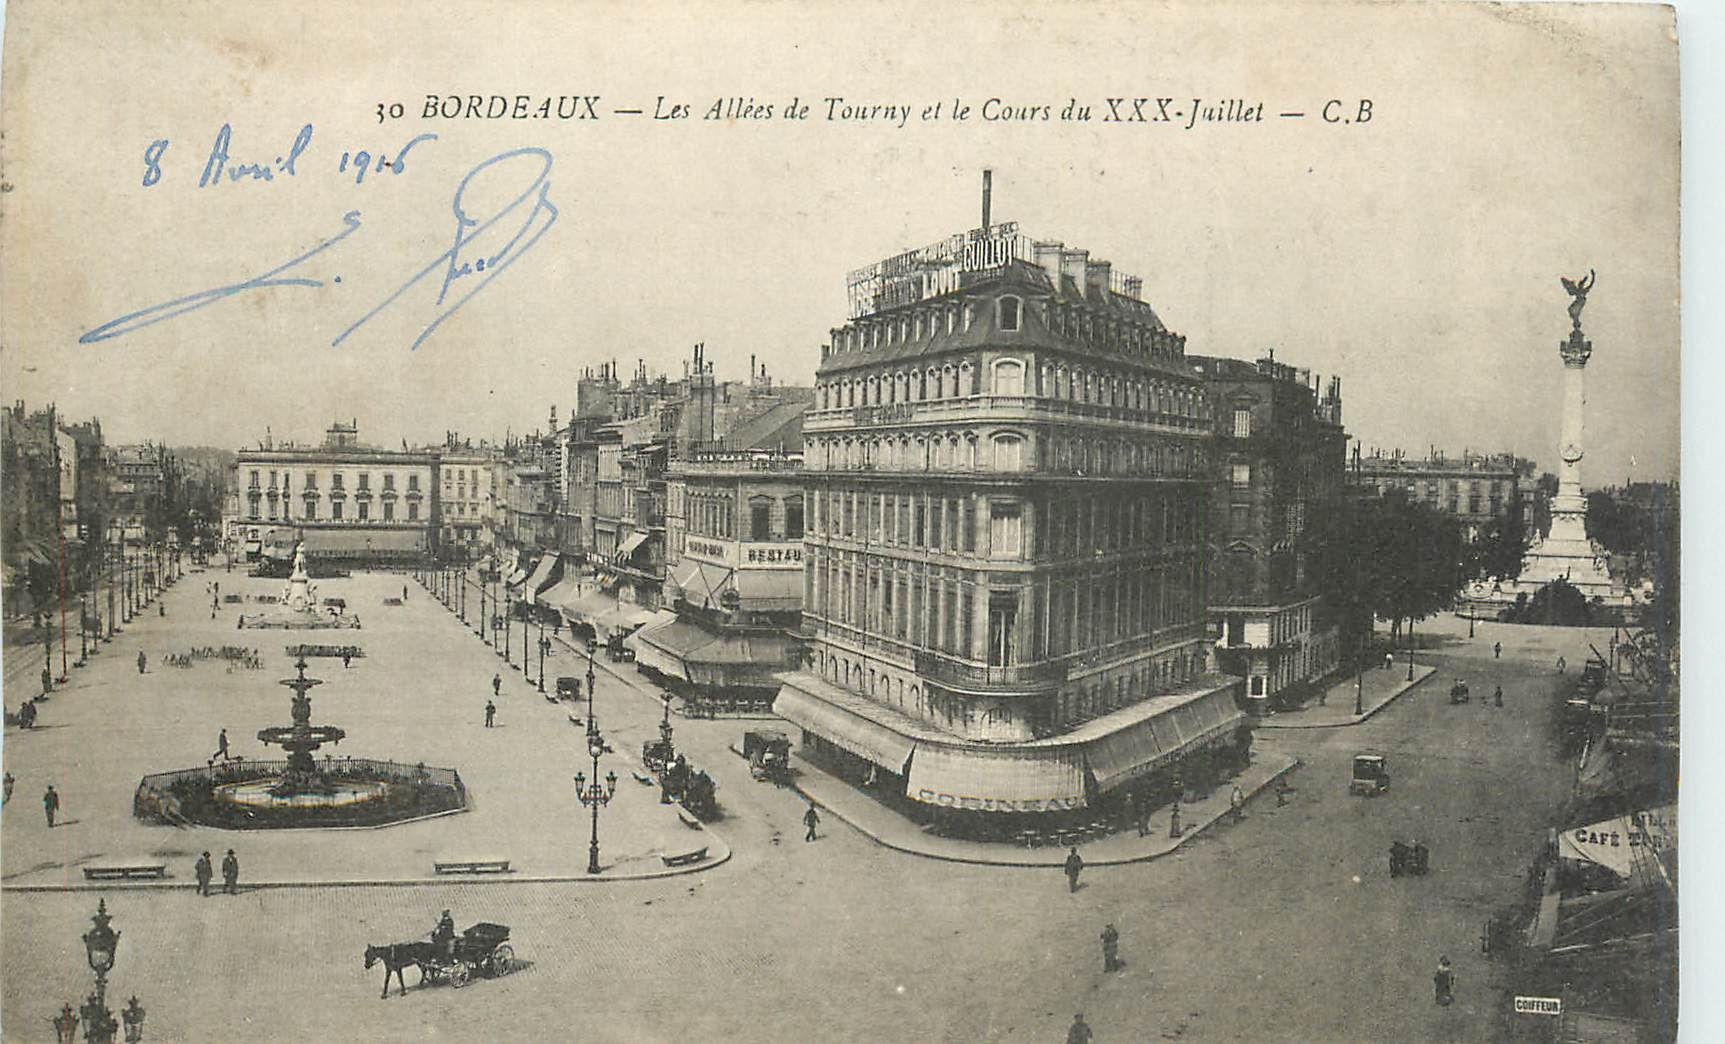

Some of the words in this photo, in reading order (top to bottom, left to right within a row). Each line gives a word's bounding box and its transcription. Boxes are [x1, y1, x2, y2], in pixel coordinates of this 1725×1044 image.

[143, 140, 169, 187] 8
[198, 123, 313, 188] Avril
[1575, 829, 1620, 847] CAFÉ
[1516, 999, 1559, 1012] COIFFEUR
